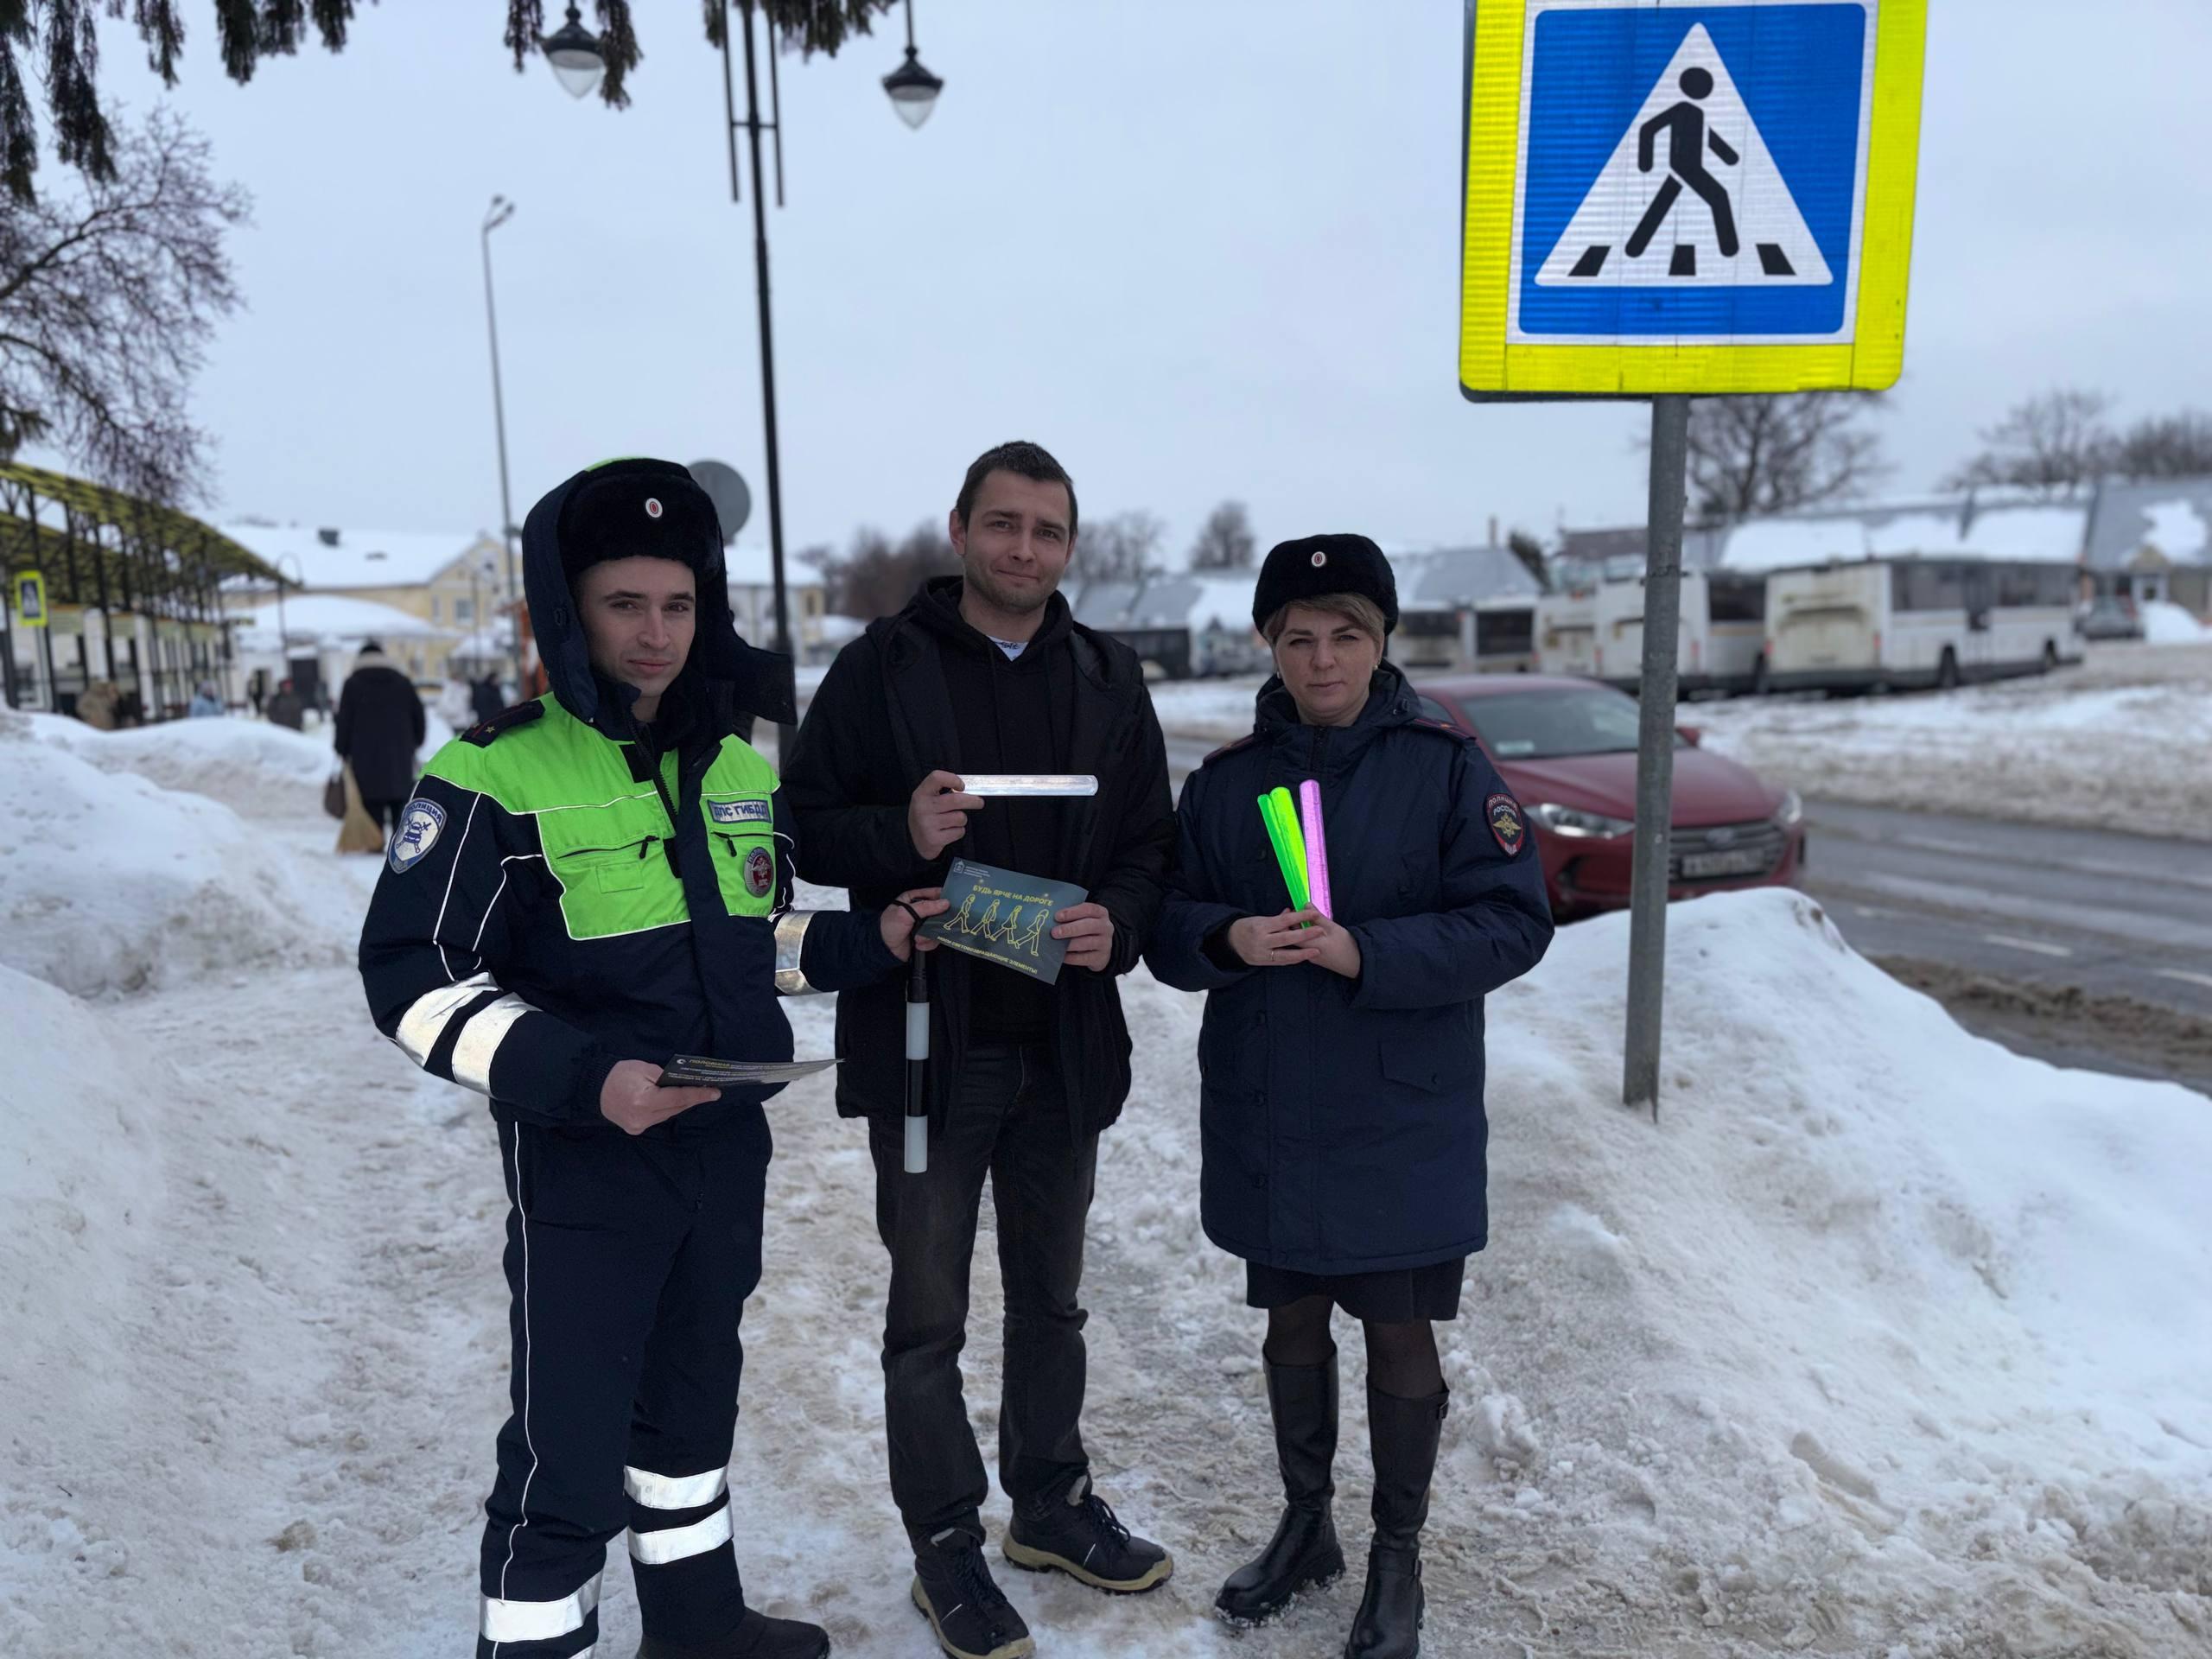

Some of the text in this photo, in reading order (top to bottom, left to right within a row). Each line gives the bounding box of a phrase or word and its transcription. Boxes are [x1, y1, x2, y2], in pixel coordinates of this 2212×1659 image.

[973, 885, 992, 894] БУДЬ
[994, 889, 1011, 899] ЯРЧЕ
[1023, 895, 1053, 906] ДОРОГЕ
